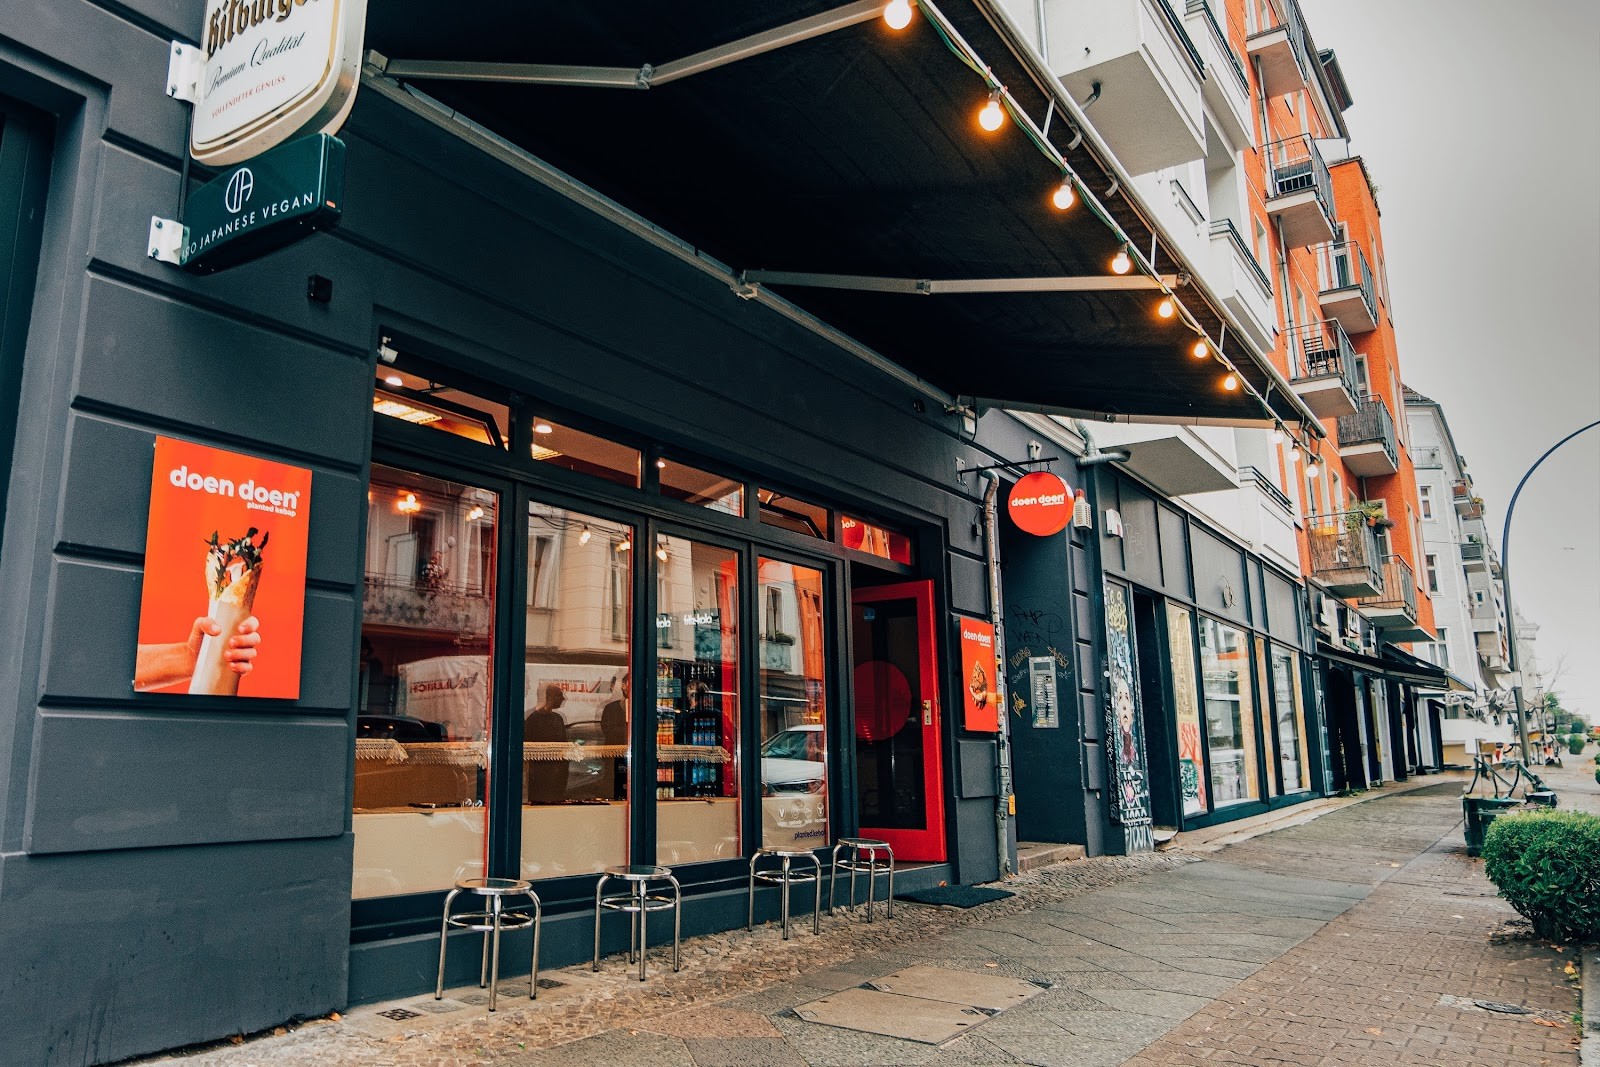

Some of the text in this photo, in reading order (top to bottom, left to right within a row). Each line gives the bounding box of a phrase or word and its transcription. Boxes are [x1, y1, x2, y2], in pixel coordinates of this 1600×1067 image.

[207, 0, 319, 62] Bitburg
[205, 31, 306, 99] Premium Qualität
[255, 75, 286, 93] GENUSS
[199, 211, 256, 249] JAPANESE
[262, 191, 314, 219] VEGAN
[169, 465, 298, 510] doen doen
[1011, 497, 1038, 507] doen
[1038, 493, 1065, 504] doen
[246, 501, 275, 513] planted
[963, 629, 978, 641] doen
